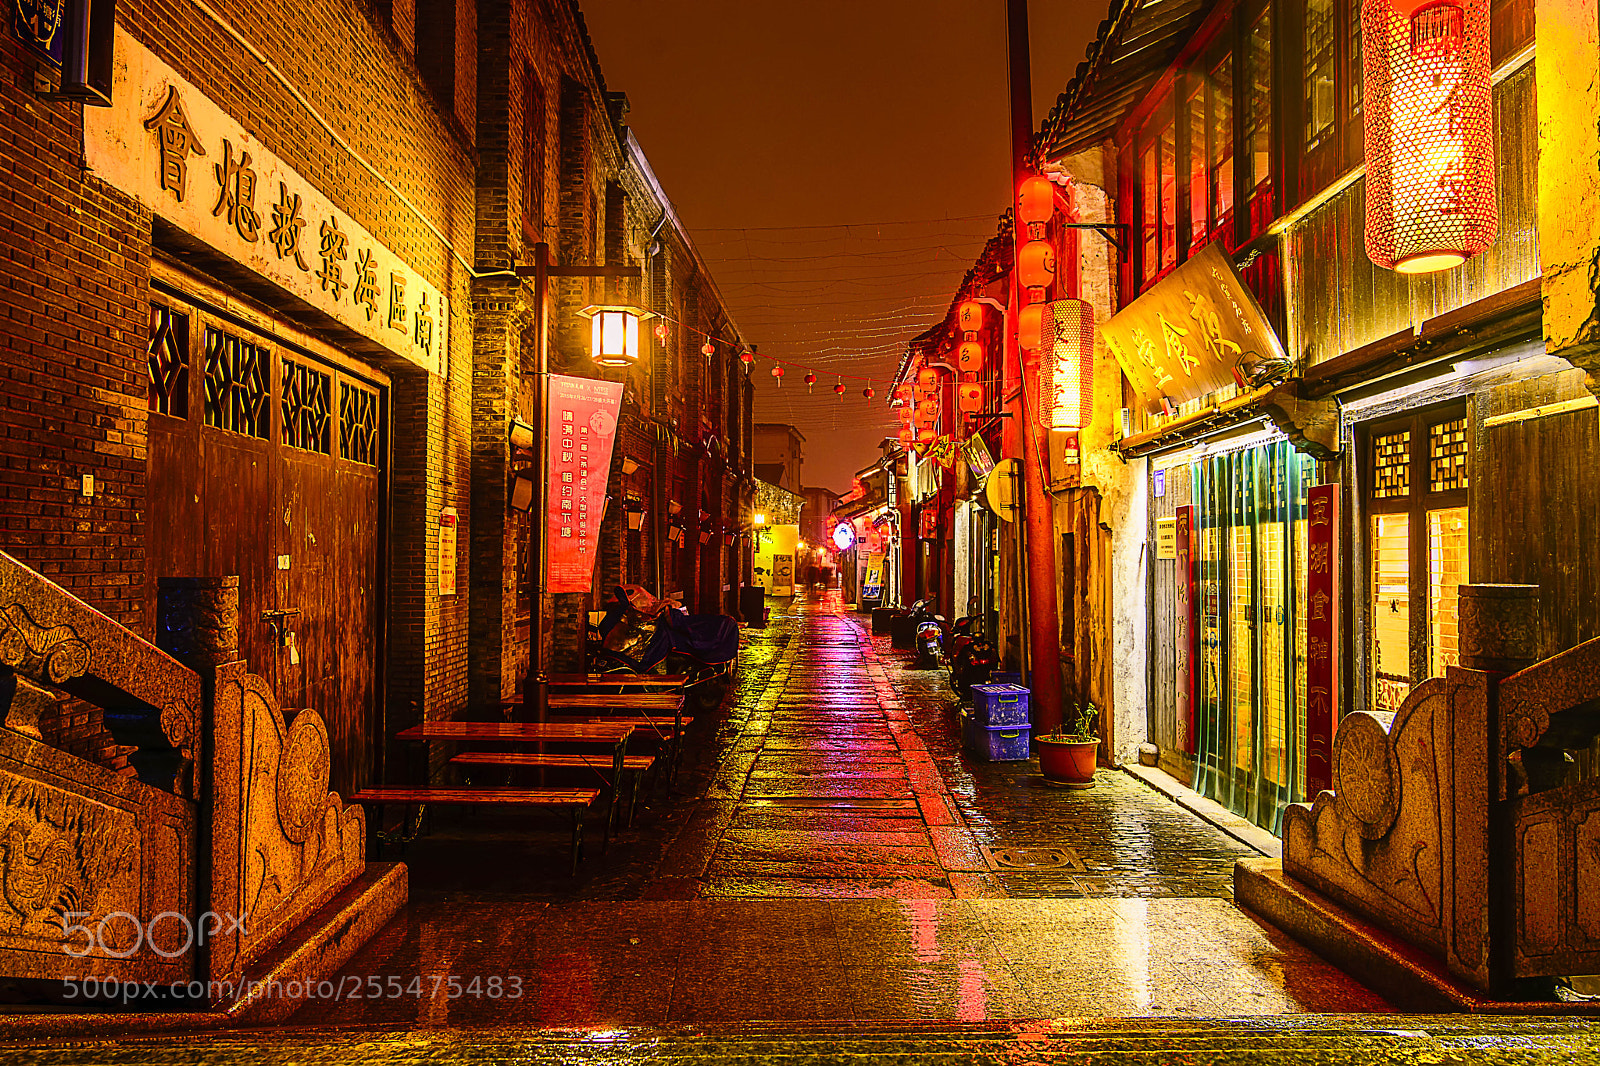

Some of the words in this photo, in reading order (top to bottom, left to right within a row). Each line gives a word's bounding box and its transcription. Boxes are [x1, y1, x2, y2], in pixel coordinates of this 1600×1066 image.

[561, 409, 574, 463] 情满中秋
[560, 471, 574, 538] 相约南下塘
